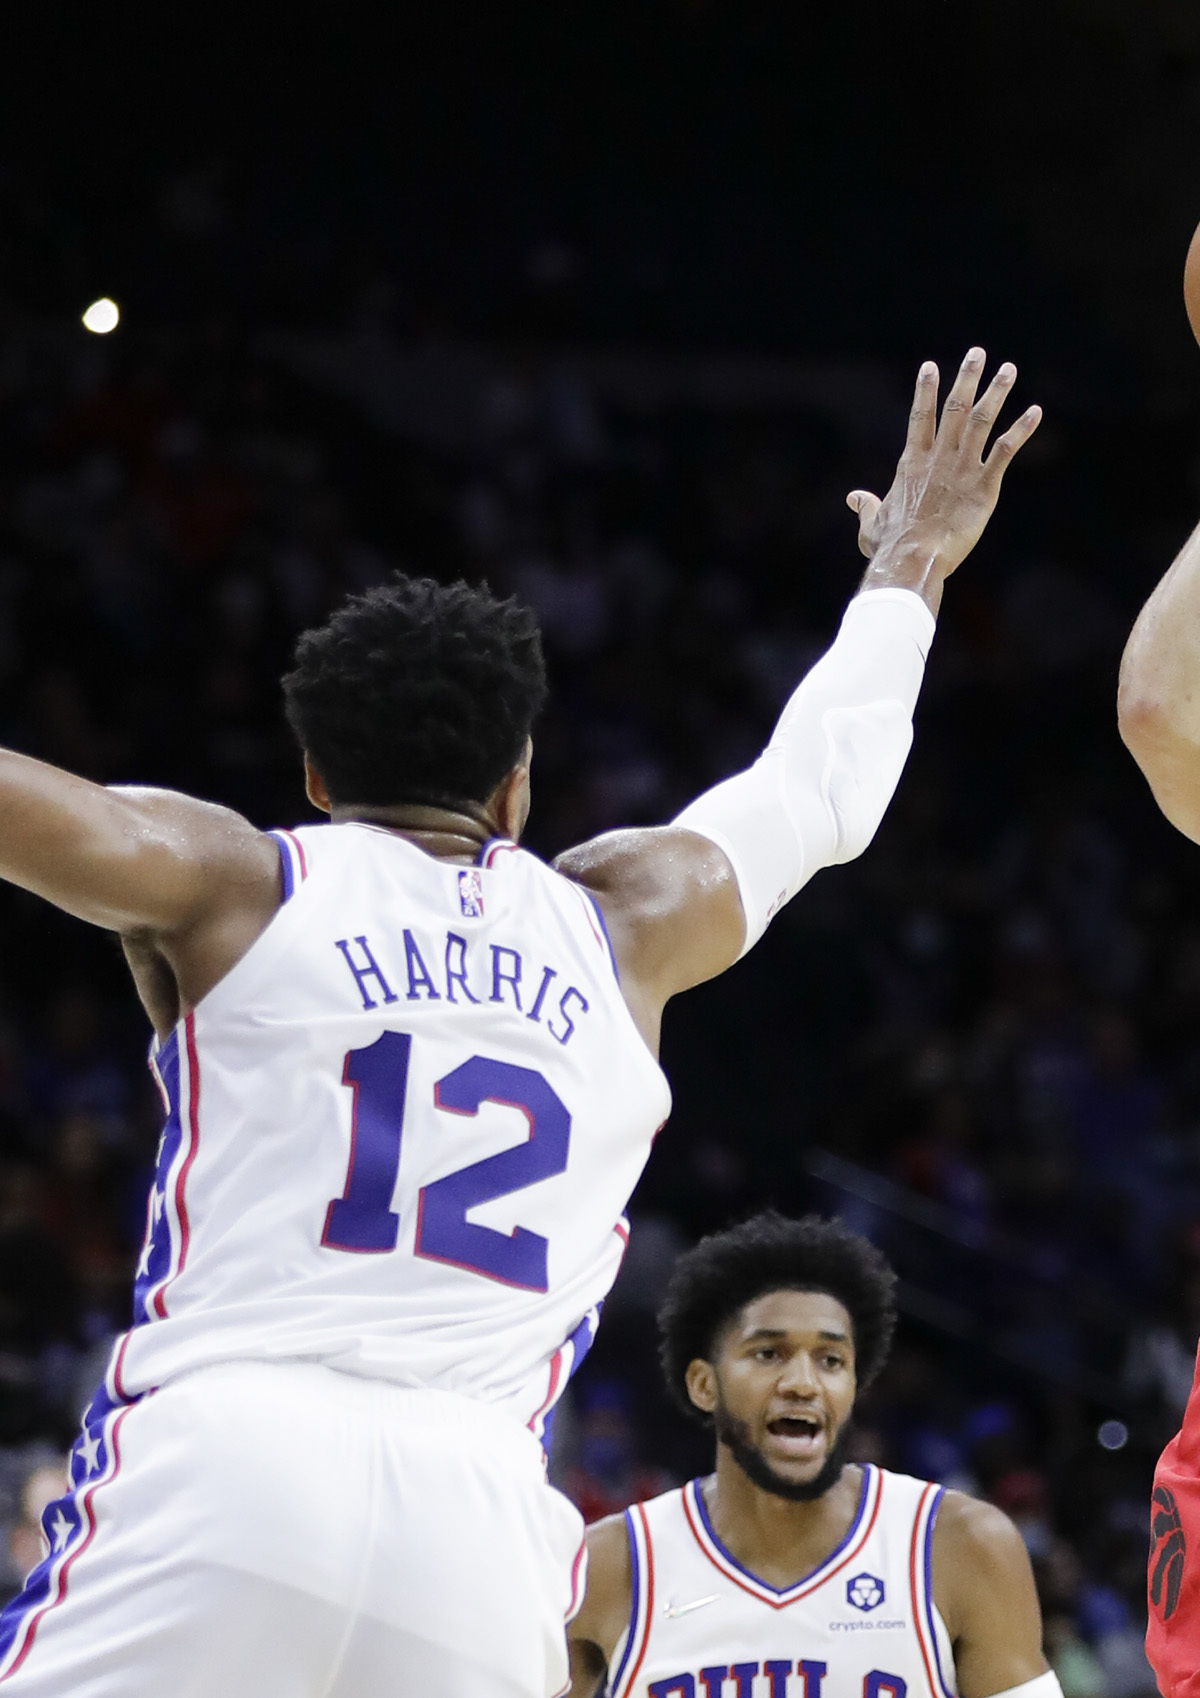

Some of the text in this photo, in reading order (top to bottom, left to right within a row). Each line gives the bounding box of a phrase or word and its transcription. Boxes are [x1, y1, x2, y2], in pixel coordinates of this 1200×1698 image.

[335, 929, 589, 1046] HARRIS
[320, 1030, 572, 1294] 12
[828, 1618, 906, 1632] crypto.com
